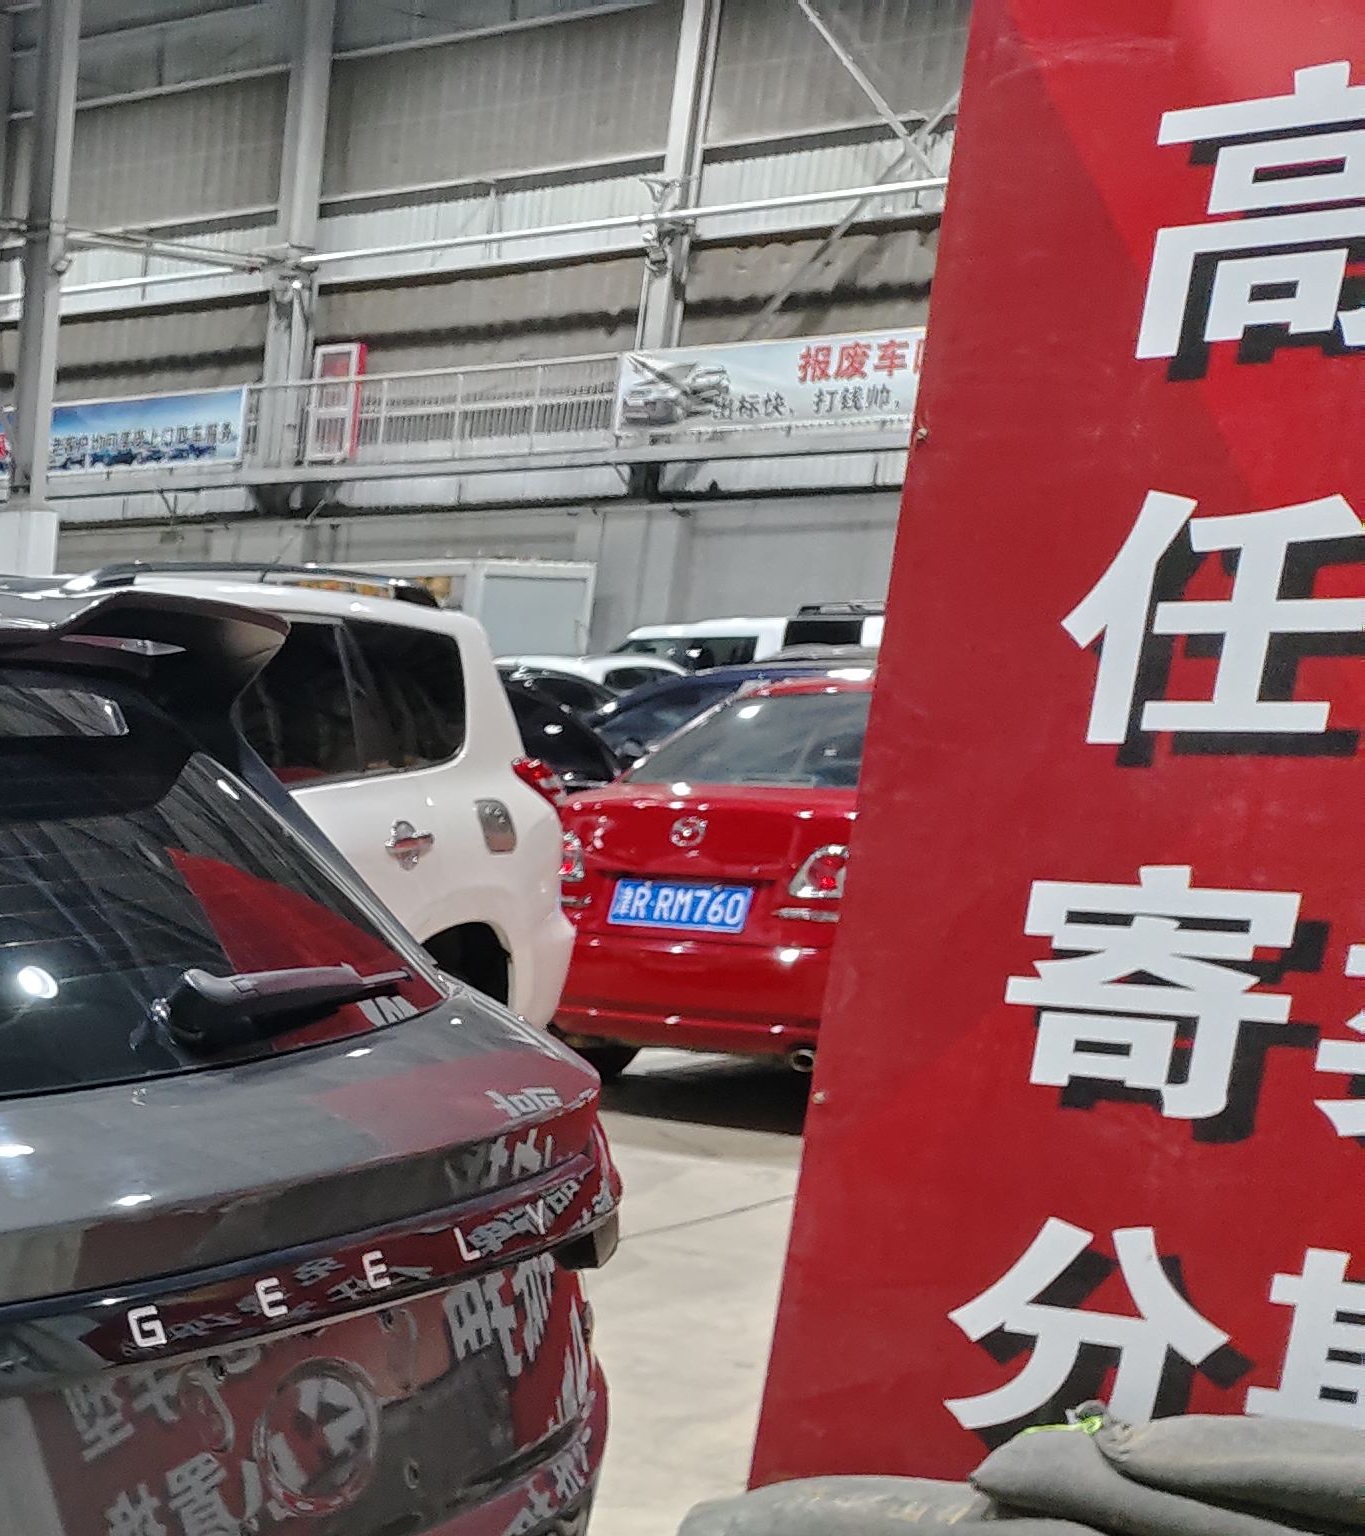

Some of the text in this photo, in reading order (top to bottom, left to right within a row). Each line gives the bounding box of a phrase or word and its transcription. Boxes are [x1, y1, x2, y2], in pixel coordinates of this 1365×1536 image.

[797, 338, 927, 383] 报废车
[1061, 490, 1365, 744] 任
[1005, 865, 1365, 1138] 寄
[126, 1199, 547, 1348] GEELY
